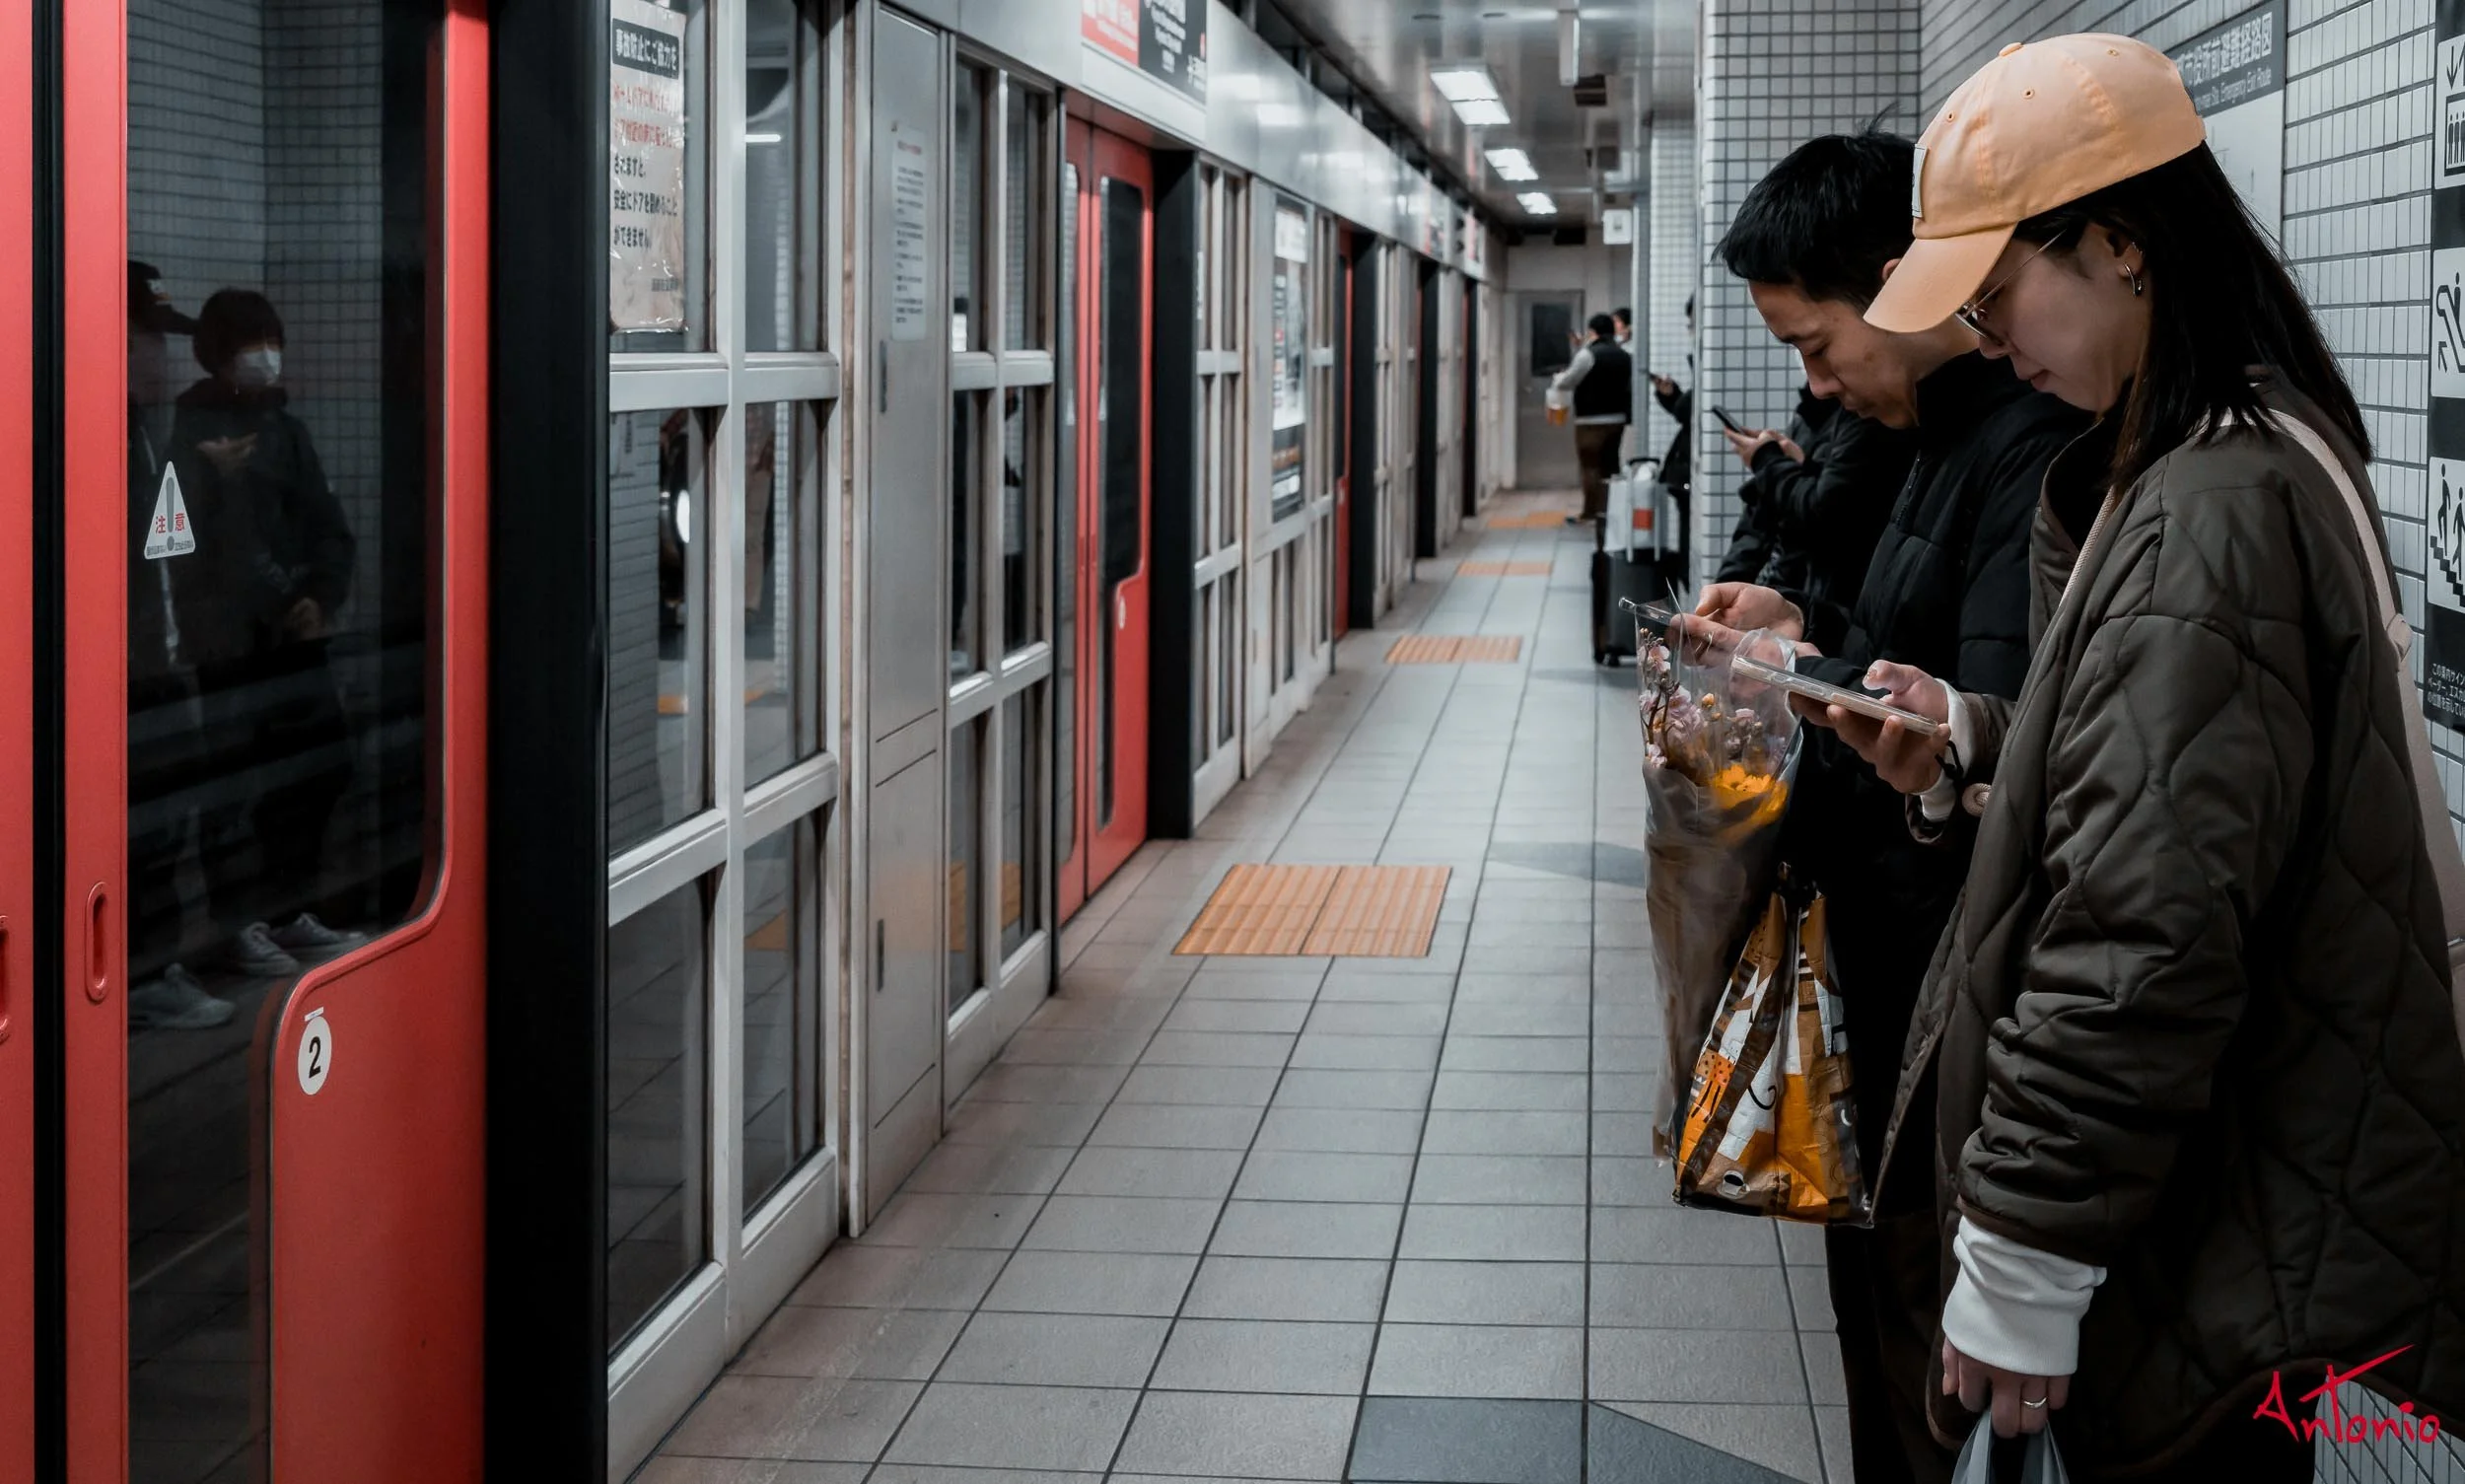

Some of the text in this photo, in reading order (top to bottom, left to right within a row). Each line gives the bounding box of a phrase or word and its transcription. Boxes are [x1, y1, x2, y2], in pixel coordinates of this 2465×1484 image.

[615, 29, 677, 71] 事故防止にご協力を
[2220, 79, 2246, 104] Emergency
[2247, 72, 2256, 93] Exit
[2257, 66, 2272, 89] Route
[156, 513, 185, 534] 注意
[309, 1036, 321, 1079] 2
